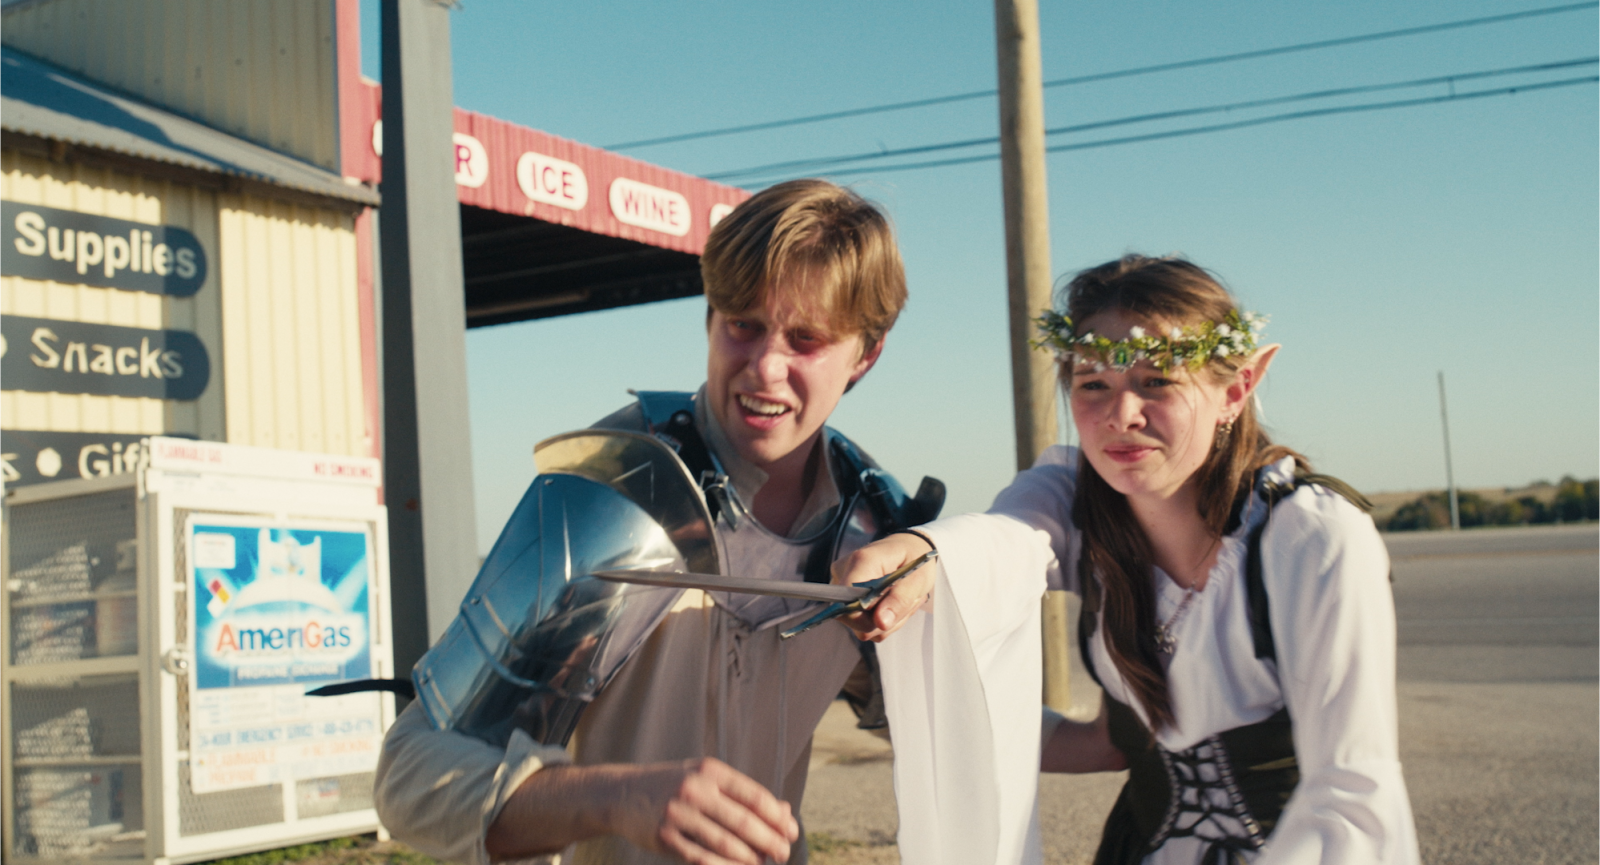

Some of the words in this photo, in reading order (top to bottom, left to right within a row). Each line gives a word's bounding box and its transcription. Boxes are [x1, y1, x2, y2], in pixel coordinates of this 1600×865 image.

[531, 161, 575, 200] ICE
[619, 186, 680, 226] WINE
[14, 211, 197, 279] Supplies
[30, 327, 184, 379] Snacks
[216, 621, 352, 652] AmeriGas
